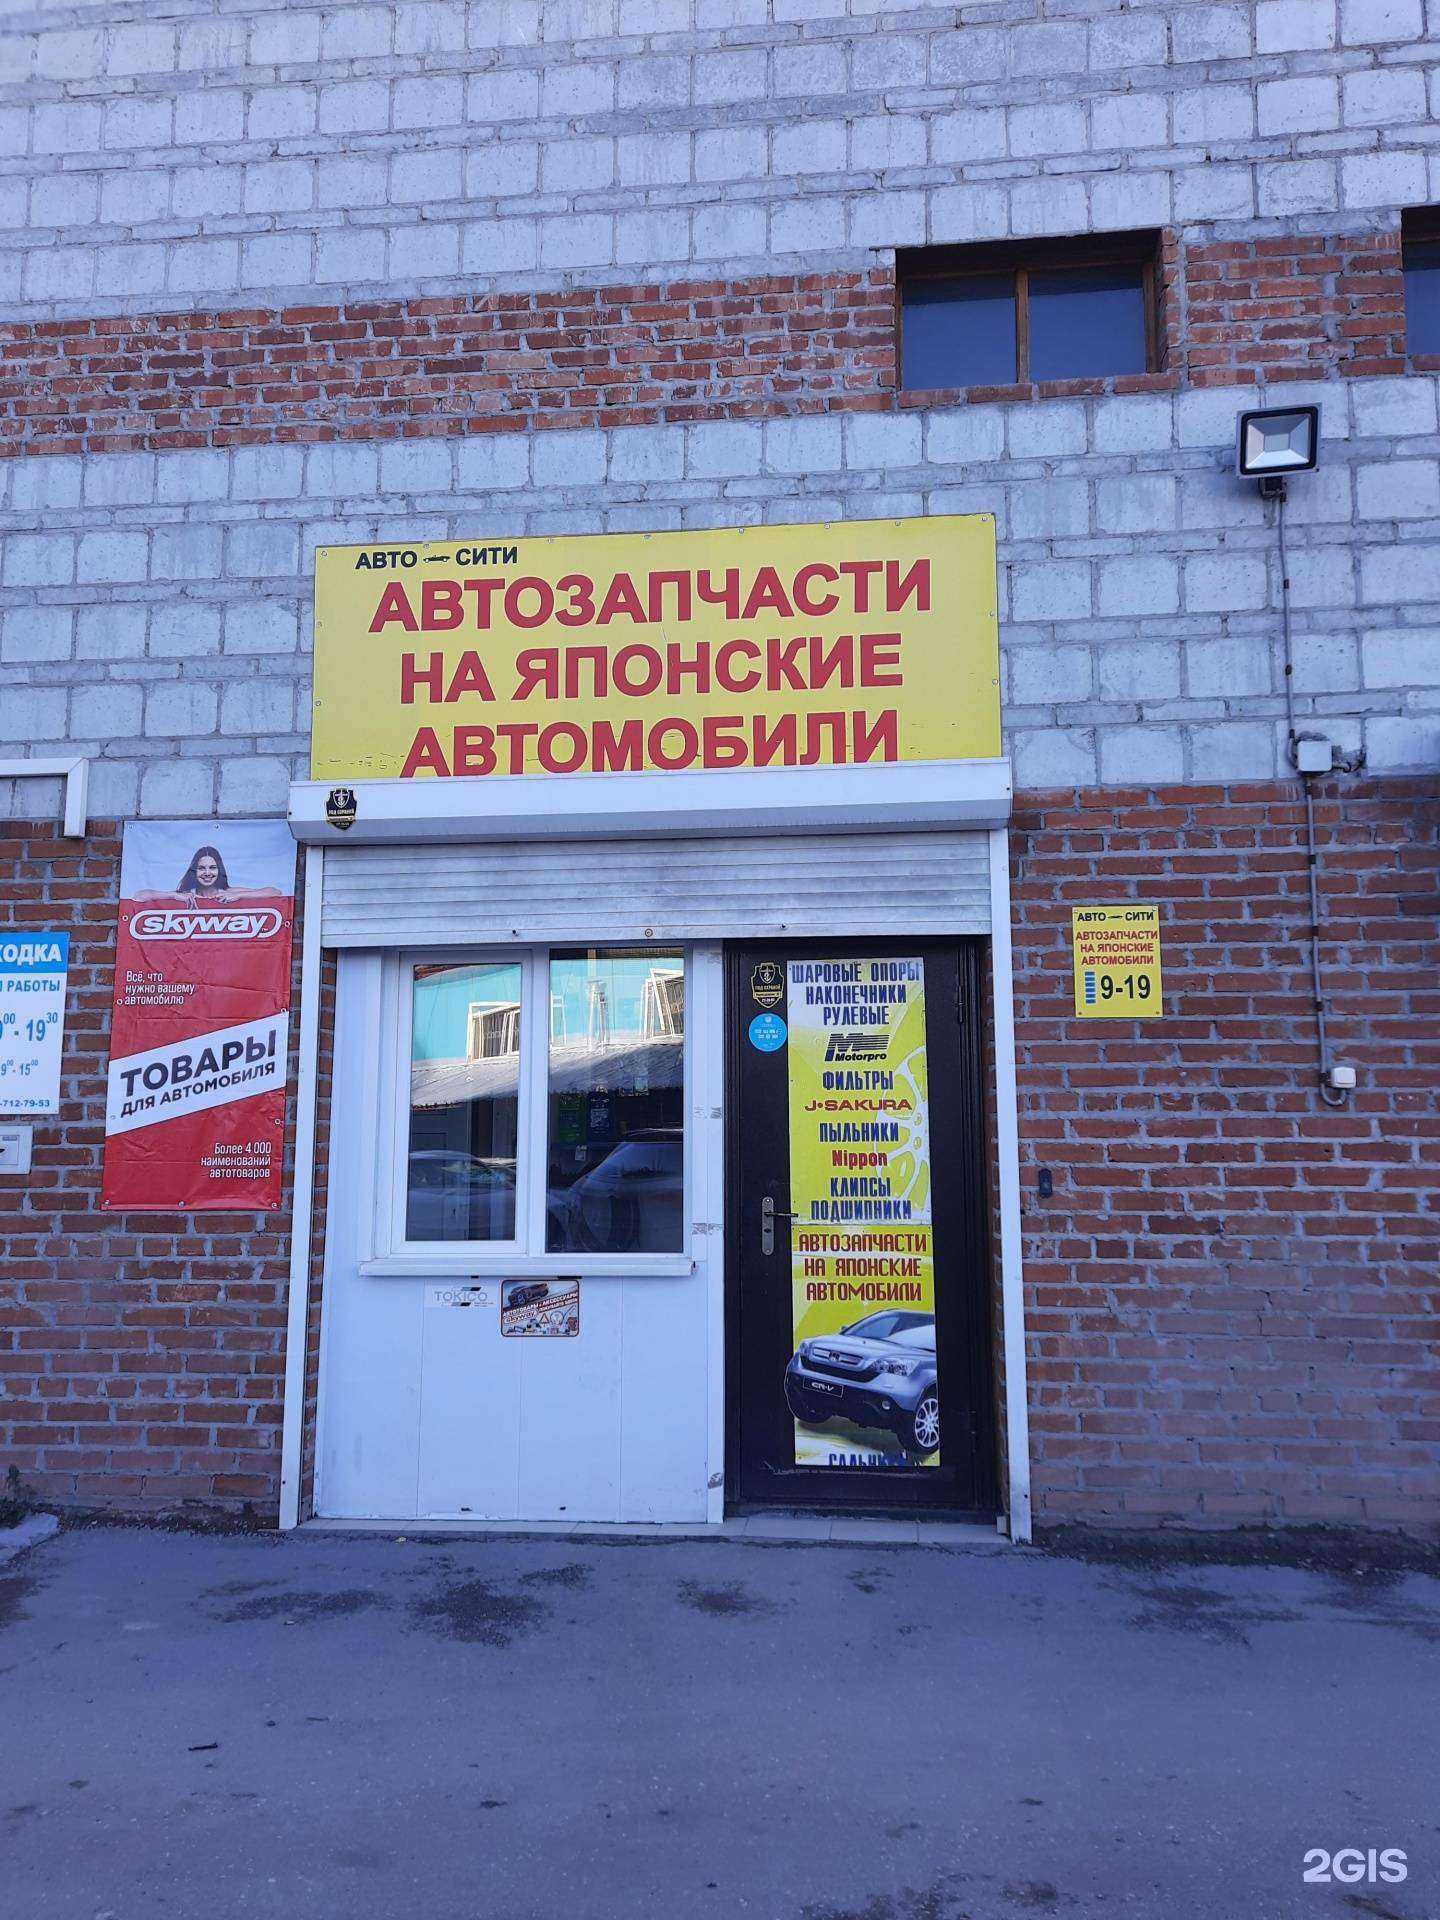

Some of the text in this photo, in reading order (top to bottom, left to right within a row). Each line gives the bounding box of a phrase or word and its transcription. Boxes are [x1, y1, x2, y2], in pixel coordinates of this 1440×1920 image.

[355, 546, 518, 570] АВТО СИТИ
[368, 558, 931, 633] АВТОЗАПЧАСТИ
[400, 633, 903, 704] НА ЯПОНСКИЕ
[400, 709, 898, 778] АВТОМОБИЛИ
[142, 910, 269, 937] skyway
[1077, 911, 1153, 921] АВТО СИТИ
[1076, 931, 1158, 941] АВТОЗАПЧАСТИ
[0, 943, 62, 966] ОДКА
[1080, 943, 1154, 952] НА ЯПОНСКИЕ
[1081, 955, 1154, 965] АВТОМОБИЛИ
[126, 970, 163, 983] Всё, что
[791, 962, 920, 983] ШАРОВЫЕ ОПОРЫ
[7, 980, 60, 992] РАБОТЫ
[125, 984, 195, 996] нужно вашему
[806, 984, 907, 1005] НАКОНЕЧНИКИ
[1100, 974, 1151, 1000] 9-19
[125, 995, 184, 1005] автомобилю
[823, 1006, 890, 1025] РУЛЕВЫЕ
[120, 1029, 277, 1097] ТОВАРЫ
[834, 1053, 888, 1062] Motorpro
[120, 1061, 275, 1118] ДЛЯ АВТОМОБИЛЯ
[822, 1071, 894, 1090] ФИЛЬТРЫ
[819, 1122, 899, 1142] ПЫЛЬНИКИ
[214, 1142, 243, 1154] Более
[201, 1155, 271, 1166] наименований
[832, 1150, 888, 1170] Nippon
[209, 1168, 270, 1178] автотоваров
[830, 1177, 891, 1197] КЛИПСЫ
[811, 1200, 912, 1222] ПОДШИПНИКИ
[799, 1234, 927, 1252] АВТОЗАПЧАСТИ
[804, 1258, 922, 1276] НА ЯПОНСКИЕ
[434, 1291, 488, 1301] TOKICO
[806, 1282, 922, 1301] АВТОМОБИЛИ
